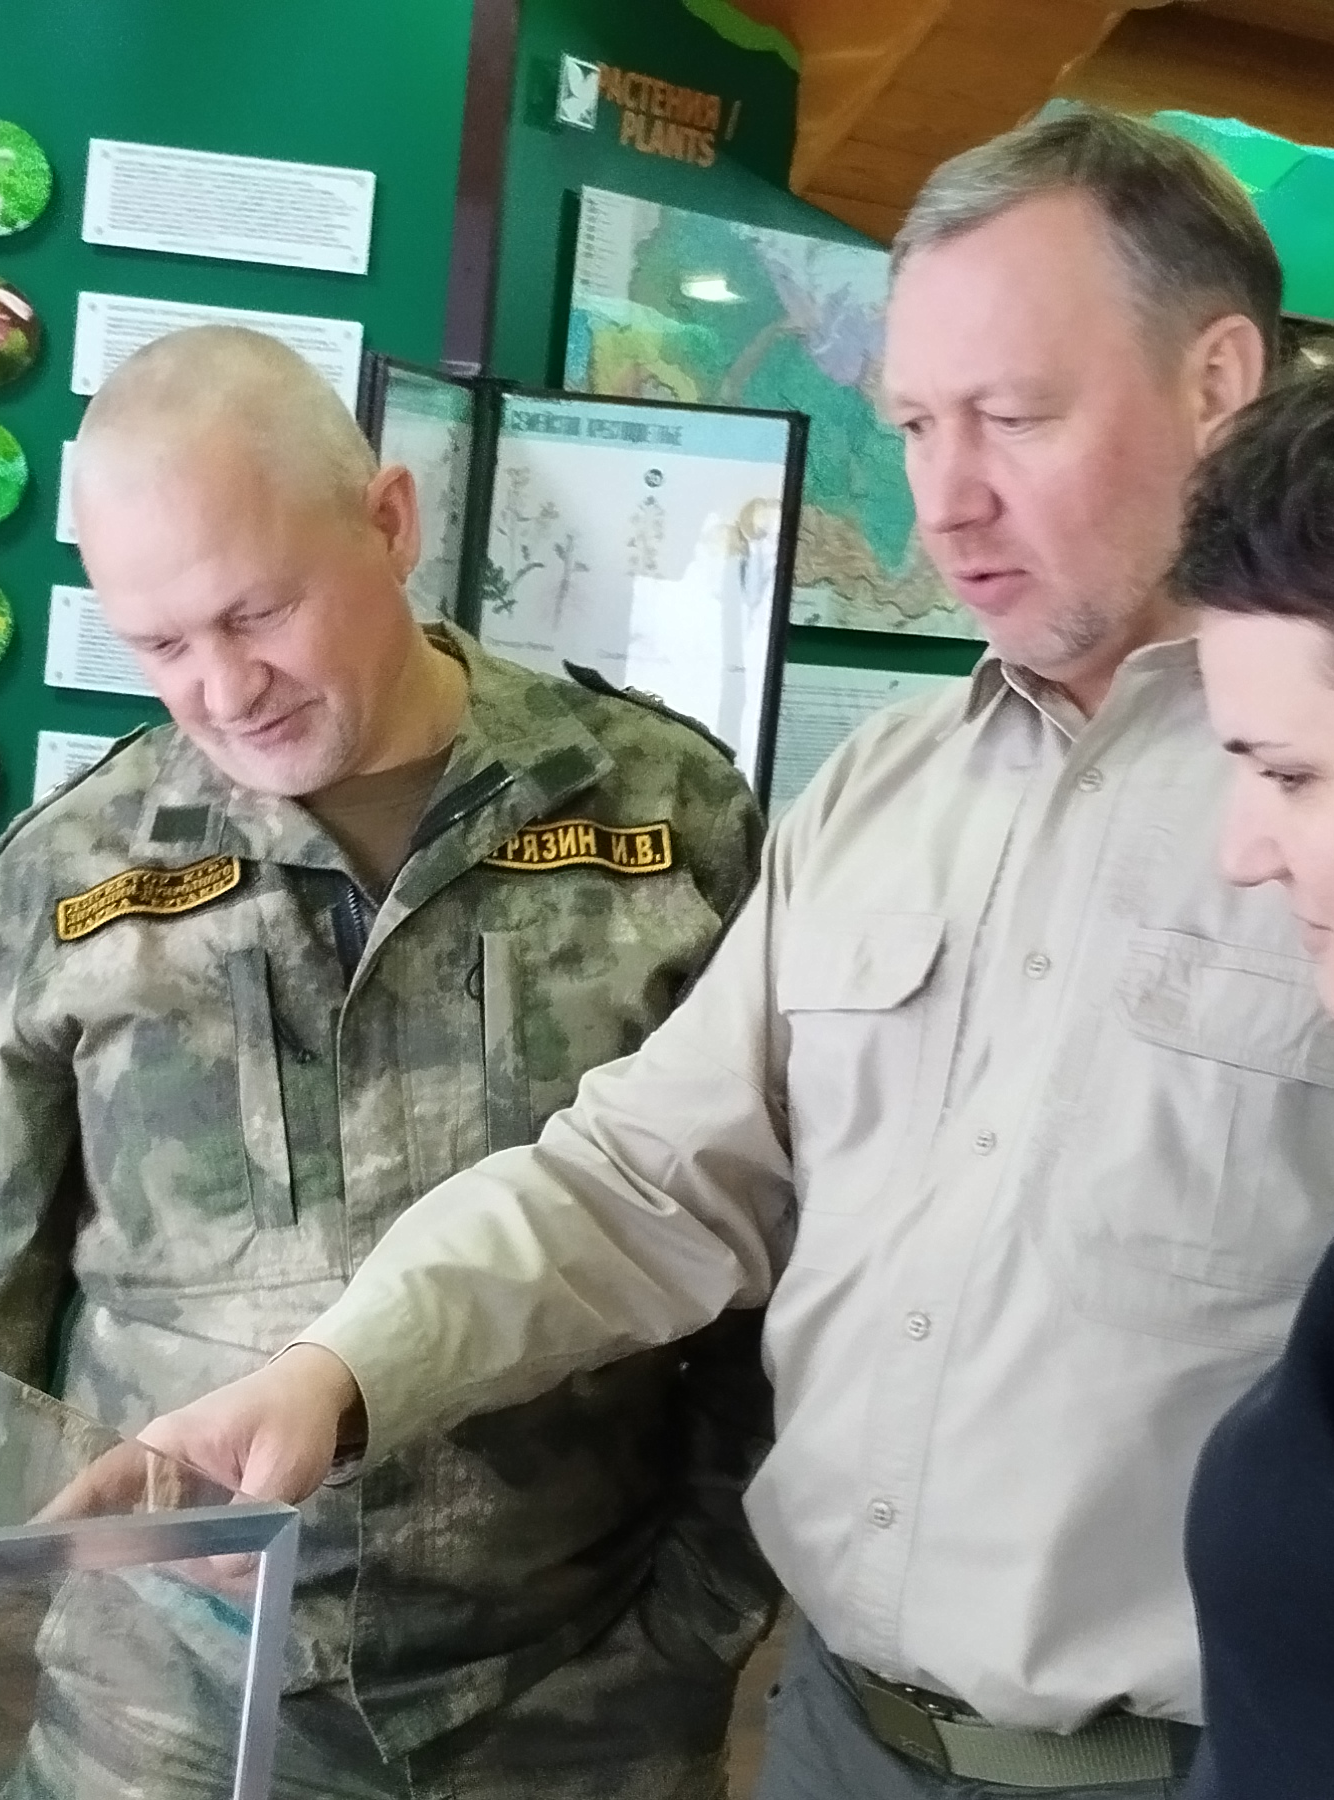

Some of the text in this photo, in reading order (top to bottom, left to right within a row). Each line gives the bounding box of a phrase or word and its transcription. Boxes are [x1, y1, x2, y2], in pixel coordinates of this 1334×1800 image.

[620, 110, 716, 168] PLANTS
[491, 825, 663, 865] РЯЗИН И.В.
